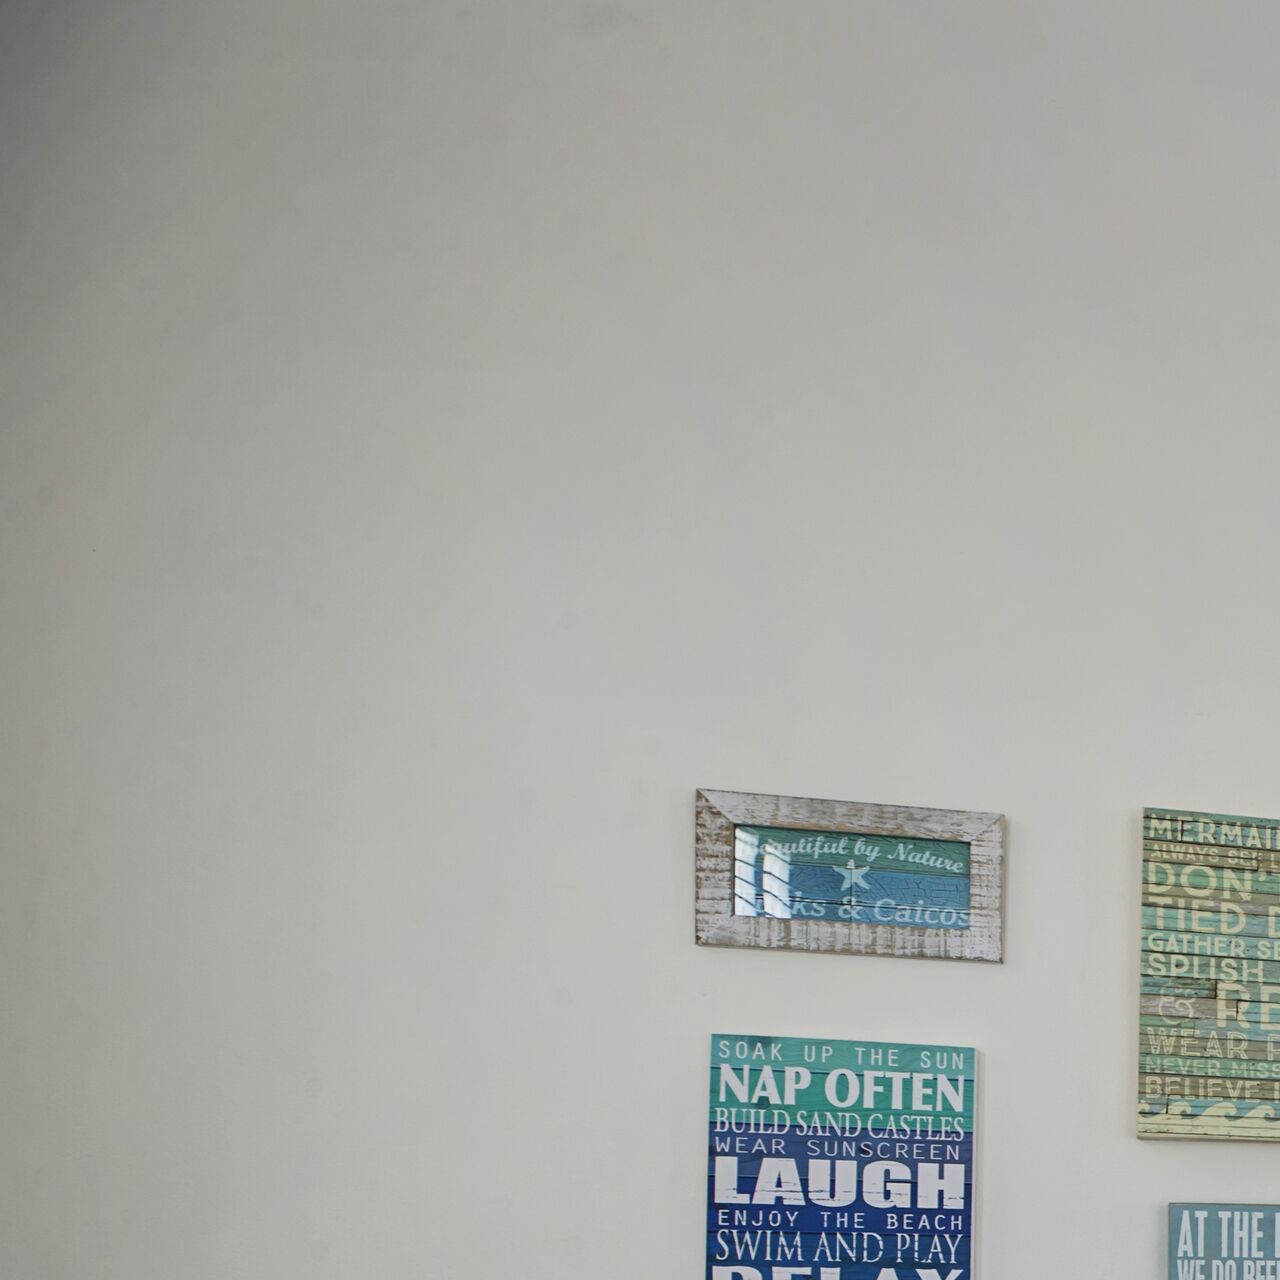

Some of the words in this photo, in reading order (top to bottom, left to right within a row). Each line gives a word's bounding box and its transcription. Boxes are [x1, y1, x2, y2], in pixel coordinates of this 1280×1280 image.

[754, 836, 850, 859] eautiful
[854, 838, 881, 861] by
[888, 844, 963, 873] Nature
[1151, 844, 1218, 862] ALWAYS
[838, 896, 863, 919] &
[1149, 897, 1246, 934] TIED
[1148, 933, 1245, 956] GATHER
[1148, 954, 1263, 985] SPLISH
[719, 1040, 782, 1061] SOAK
[804, 1046, 832, 1063] UP
[855, 1048, 898, 1067] THE
[920, 1051, 964, 1070] SUN
[1147, 1027, 1248, 1059] WEAR
[1146, 1057, 1220, 1076] NEVER
[720, 1064, 811, 1105] NAP
[825, 1069, 964, 1112] OFTEN
[1146, 1076, 1260, 1100] BELIEVE
[715, 1108, 790, 1134] BUILD
[796, 1111, 860, 1137] SAND
[867, 1113, 964, 1141] CASTLES
[716, 1137, 786, 1155] WEAR
[807, 1140, 959, 1160] SUNSCREEN
[714, 1156, 965, 1210] LAUGH
[718, 1210, 799, 1227] ENJOY
[821, 1212, 865, 1228] THE
[887, 1213, 962, 1230] BEACH
[1177, 1210, 1208, 1257] AT
[1218, 1211, 1264, 1258] THE
[716, 1230, 803, 1261] SWIM
[815, 1232, 884, 1263] AND
[897, 1234, 963, 1263] PLAY
